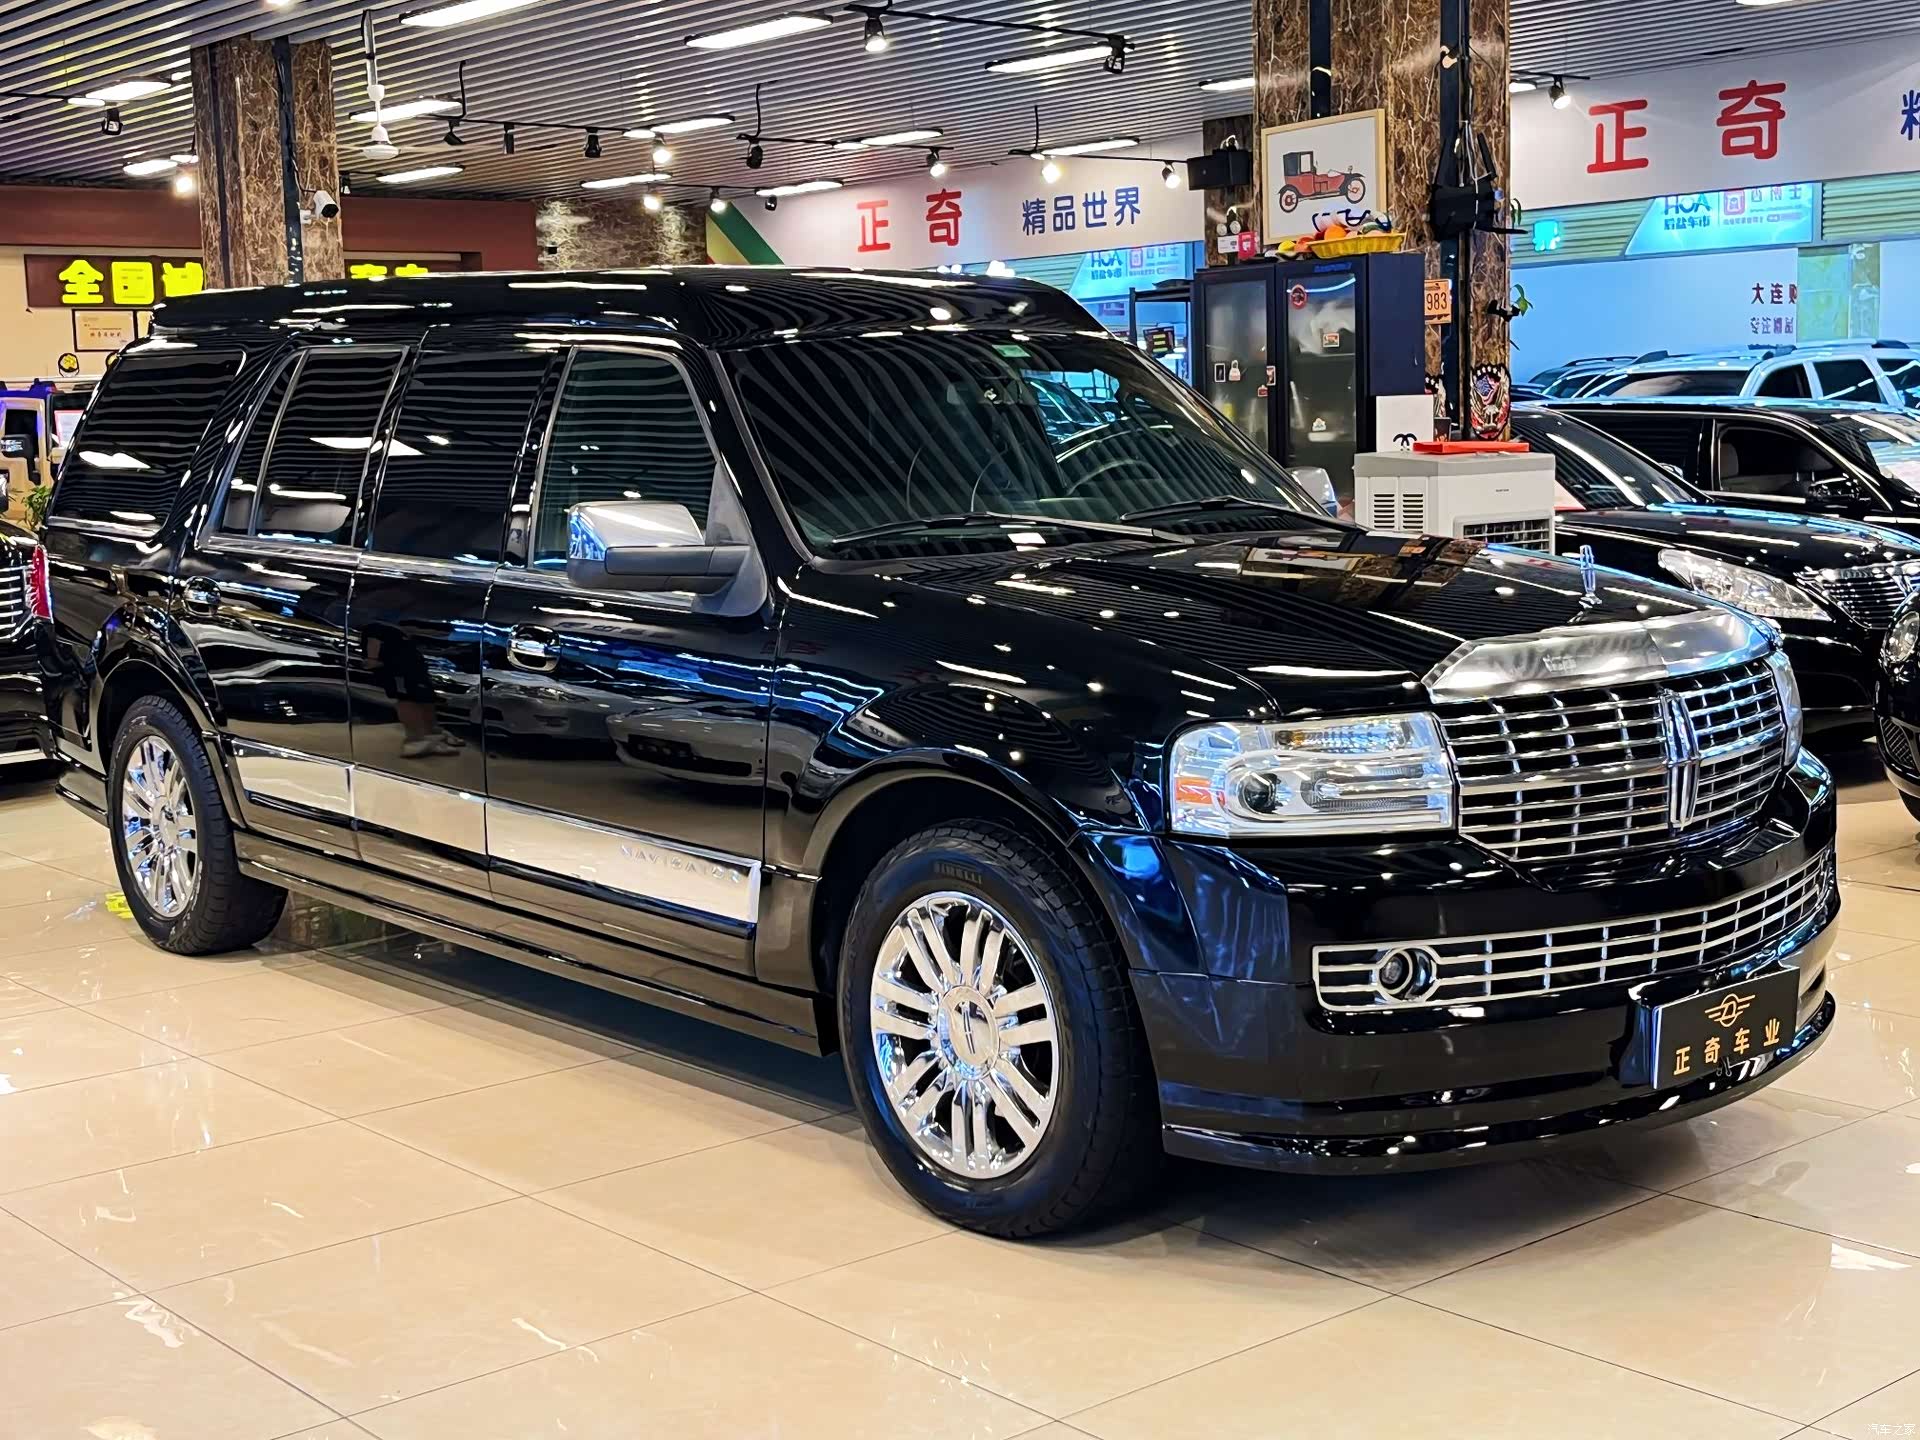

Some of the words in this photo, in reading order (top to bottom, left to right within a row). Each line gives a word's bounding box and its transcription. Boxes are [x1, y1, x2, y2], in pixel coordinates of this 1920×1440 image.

[1586, 79, 1787, 174] 正奇
[857, 188, 963, 252] 正奇
[1021, 186, 1141, 237] 精品世界
[1426, 292, 1448, 311] 983
[1673, 1017, 1781, 1076] 正奇车业
